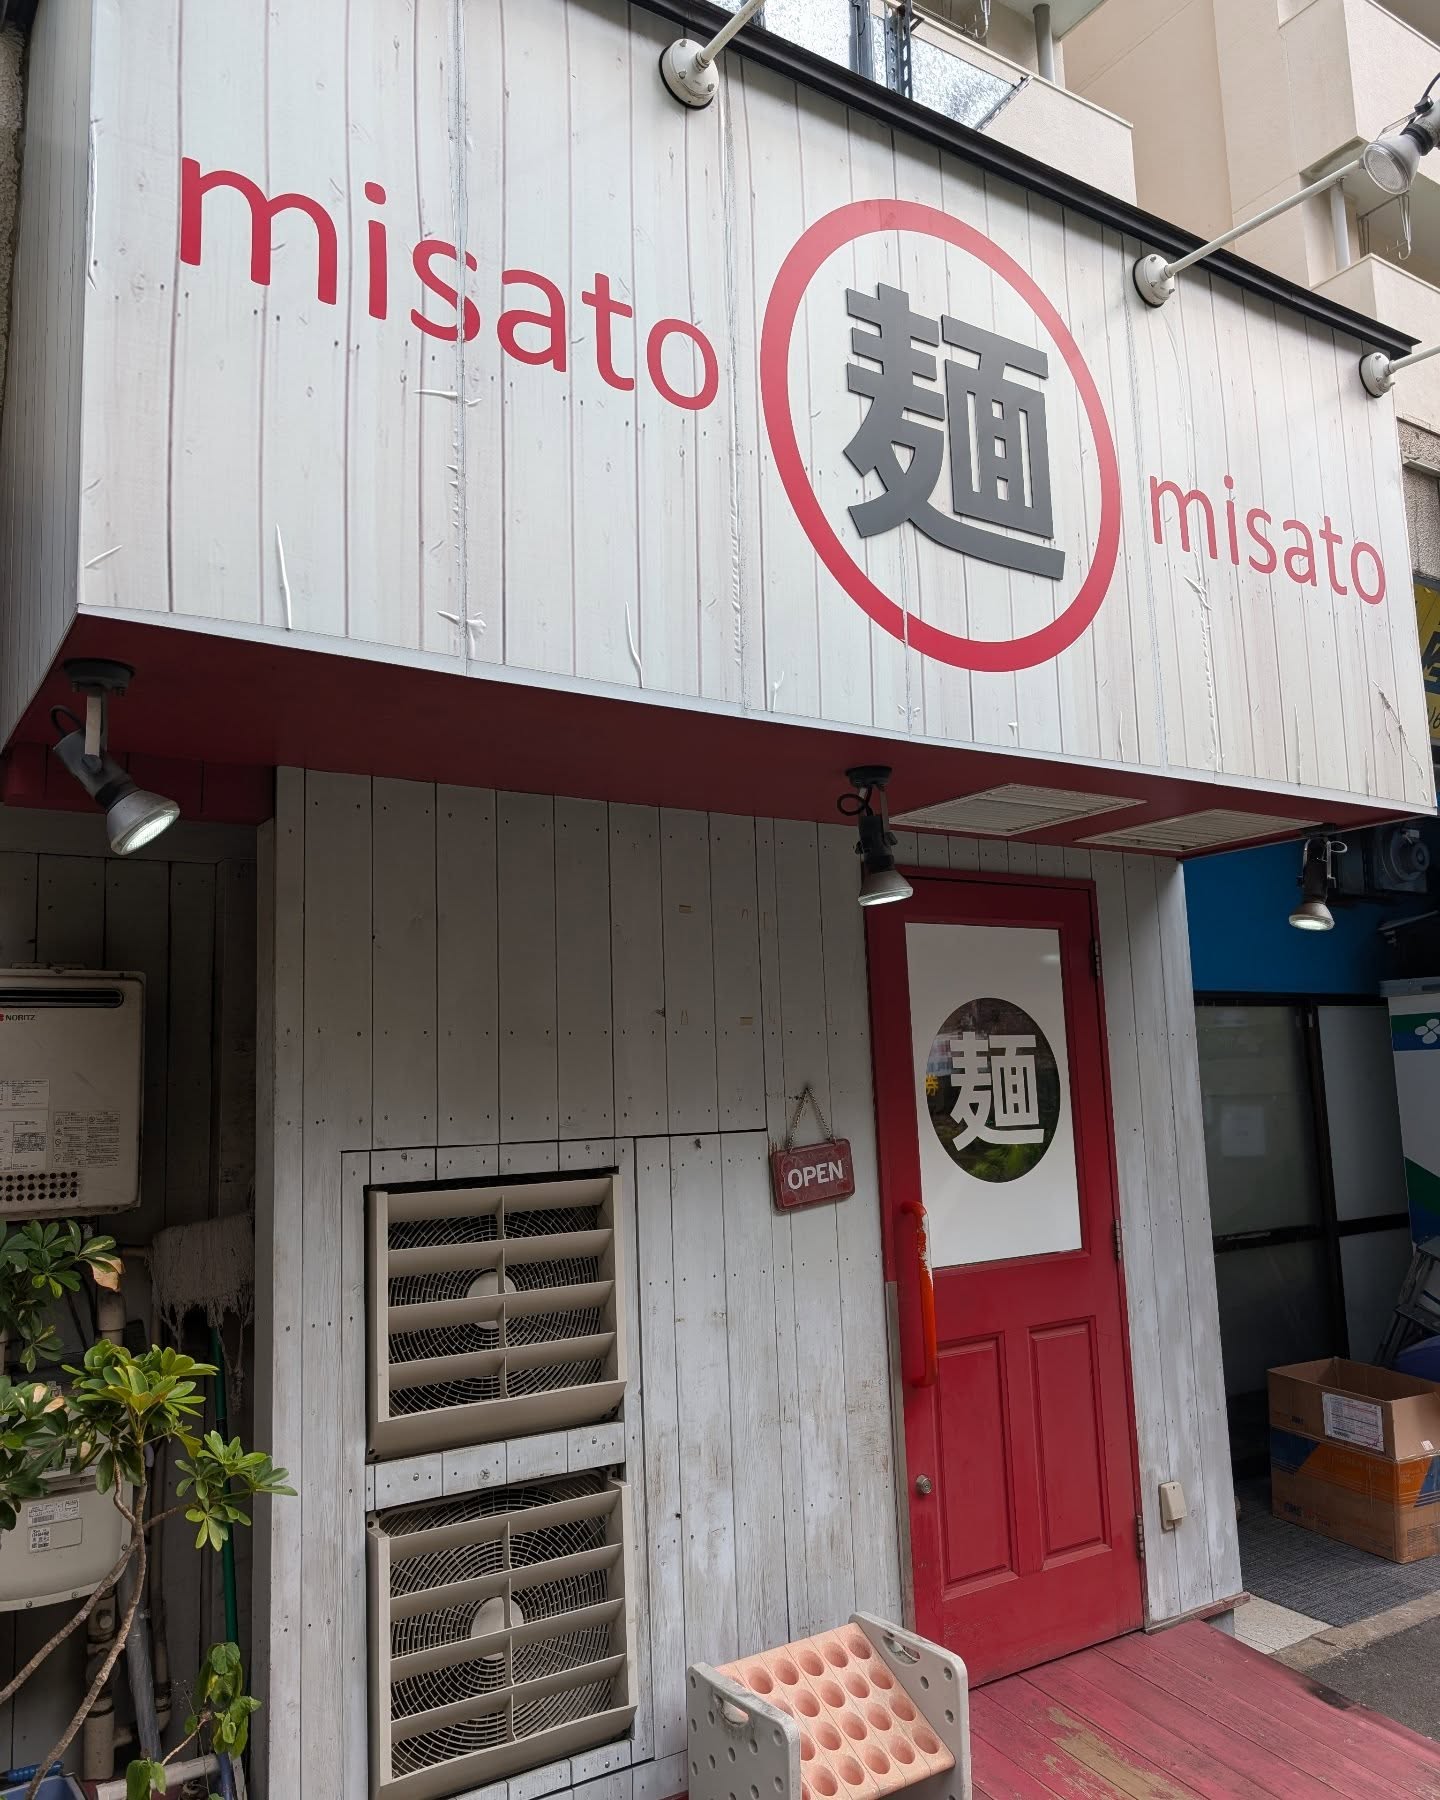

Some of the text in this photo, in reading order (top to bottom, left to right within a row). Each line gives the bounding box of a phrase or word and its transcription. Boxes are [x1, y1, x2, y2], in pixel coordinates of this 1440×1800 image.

[180, 156, 719, 411] misato
[842, 282, 1066, 581] 麺
[1149, 474, 1387, 605] misato
[949, 1031, 1045, 1151] 麺
[787, 1159, 844, 1191] OPEN
